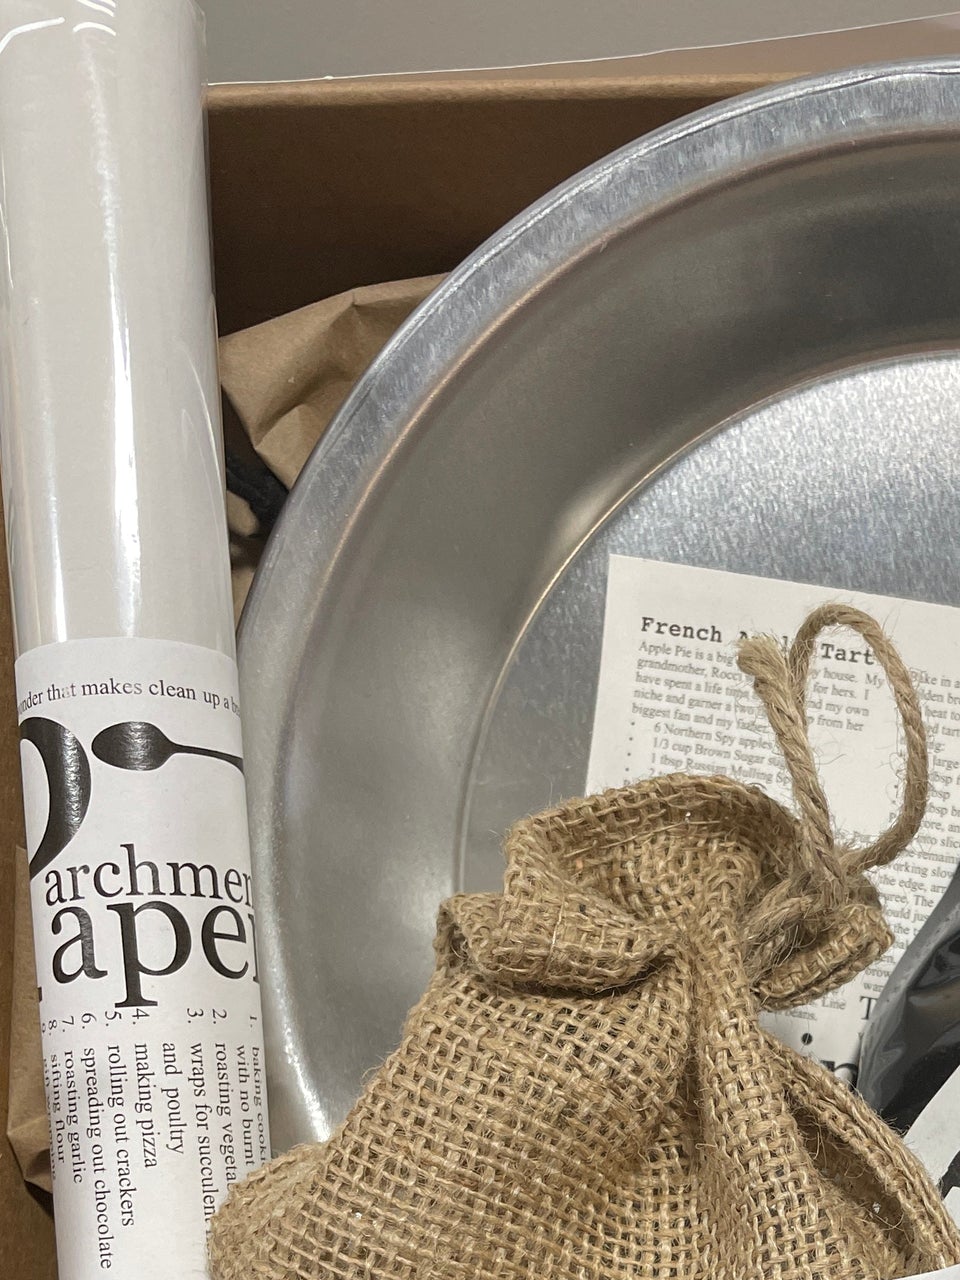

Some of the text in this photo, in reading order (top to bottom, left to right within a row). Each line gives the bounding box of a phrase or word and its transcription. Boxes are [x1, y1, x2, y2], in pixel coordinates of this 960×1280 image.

[639, 642, 672, 655] Apple
[674, 645, 692, 658] Pie
[641, 617, 722, 643] French
[821, 644, 876, 665] Tart
[48, 682, 77, 702] that
[81, 678, 143, 696] makes
[148, 680, 197, 701] clean
[202, 690, 220, 710] up
[223, 698, 230, 710] a
[663, 724, 712, 741] Northern
[715, 732, 735, 746] Spy
[187, 1008, 203, 1024] 3.
[212, 1008, 227, 1025] 2.
[48, 1020, 65, 1164] 8. sifting flour
[62, 1016, 86, 1184] 7. roasting garlic
[132, 1008, 160, 1169] 4. making pizza
[161, 1042, 188, 1155] and poultry
[188, 1043, 206, 1097] wraps
[215, 1042, 232, 1118] roasting
[251, 1046, 262, 1108] baking
[105, 1011, 137, 1227] 5. rolling out crackers
[195, 1104, 213, 1131] for
[236, 1045, 256, 1166] with no burnt
[80, 1012, 115, 1270] 6. spreading out chocolate
